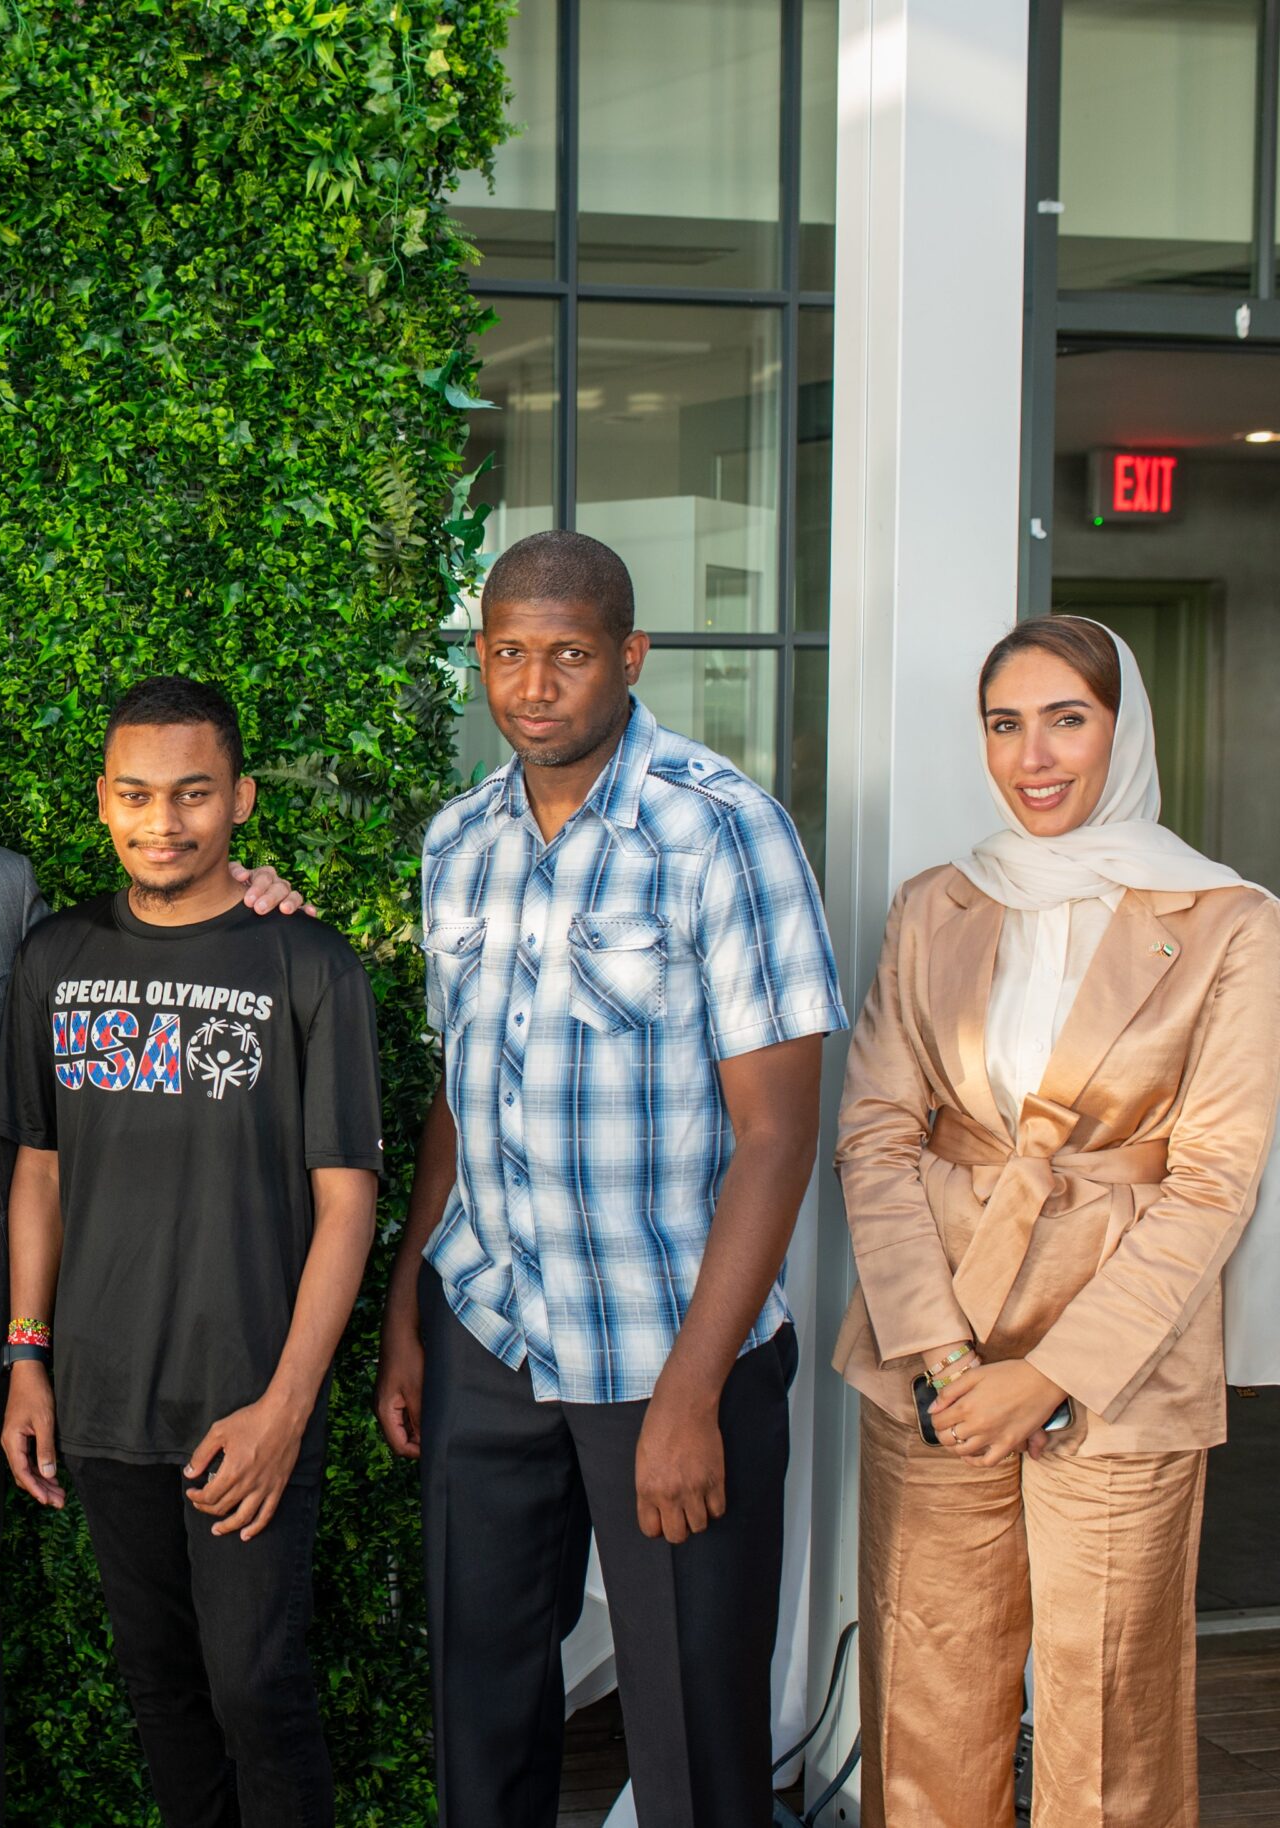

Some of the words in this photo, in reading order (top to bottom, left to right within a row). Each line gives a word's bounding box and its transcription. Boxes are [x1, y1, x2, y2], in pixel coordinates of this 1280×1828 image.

[1113, 455, 1177, 512] EXIT
[55, 980, 140, 1005] SPECIAL
[146, 981, 273, 1021] OLYMPICS
[53, 1009, 182, 1094] USA
